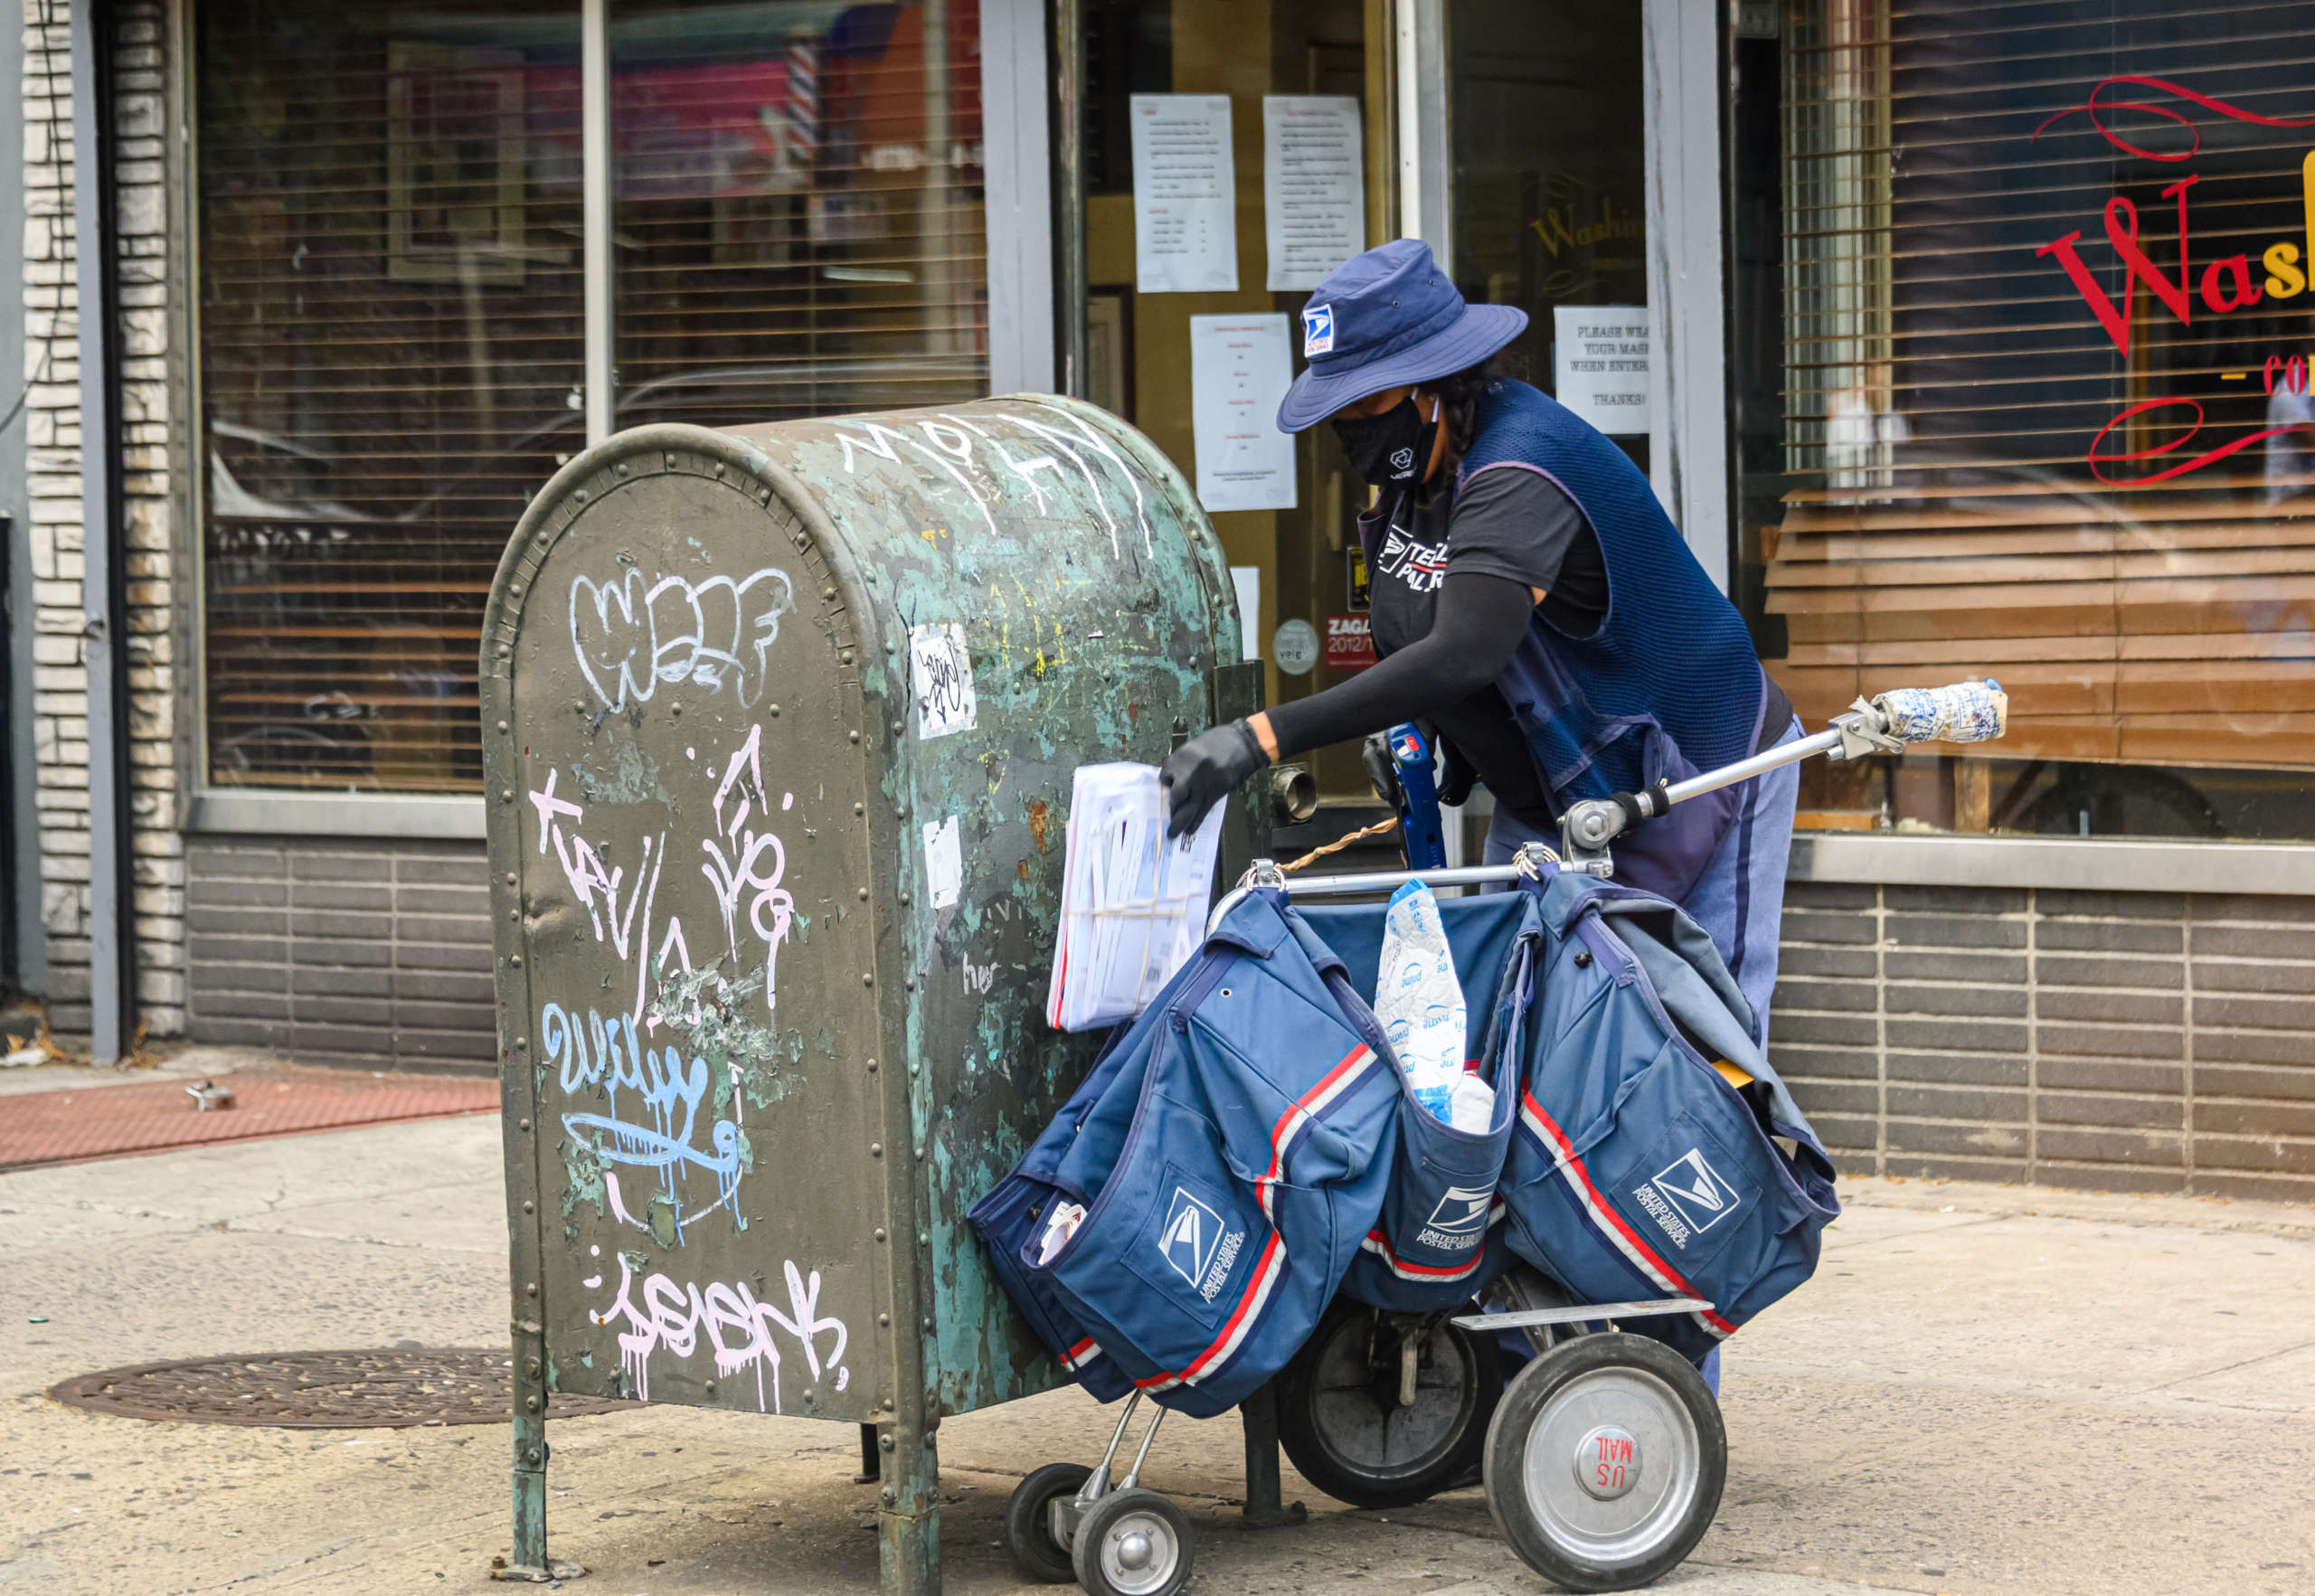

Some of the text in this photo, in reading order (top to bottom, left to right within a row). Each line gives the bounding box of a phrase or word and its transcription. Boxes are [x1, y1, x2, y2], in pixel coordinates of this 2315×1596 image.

[2036, 150, 2315, 358] Was
[1577, 326, 1622, 338] PLEASE
[1584, 344, 1616, 354] YOUR
[1570, 361, 1649, 372] WHEN ENTER
[1631, 1187, 1660, 1219] POSTAL
[1641, 1183, 1691, 1238] UNITED STATES
[1416, 1234, 1453, 1251] POSTAL
[1421, 1228, 1460, 1243] UNITED
[1199, 1231, 1234, 1298] UNITED STATES
[1205, 1269, 1230, 1305] POSTAL
[1594, 1437, 1632, 1464] MAIL
[1596, 1463, 1626, 1489] US
